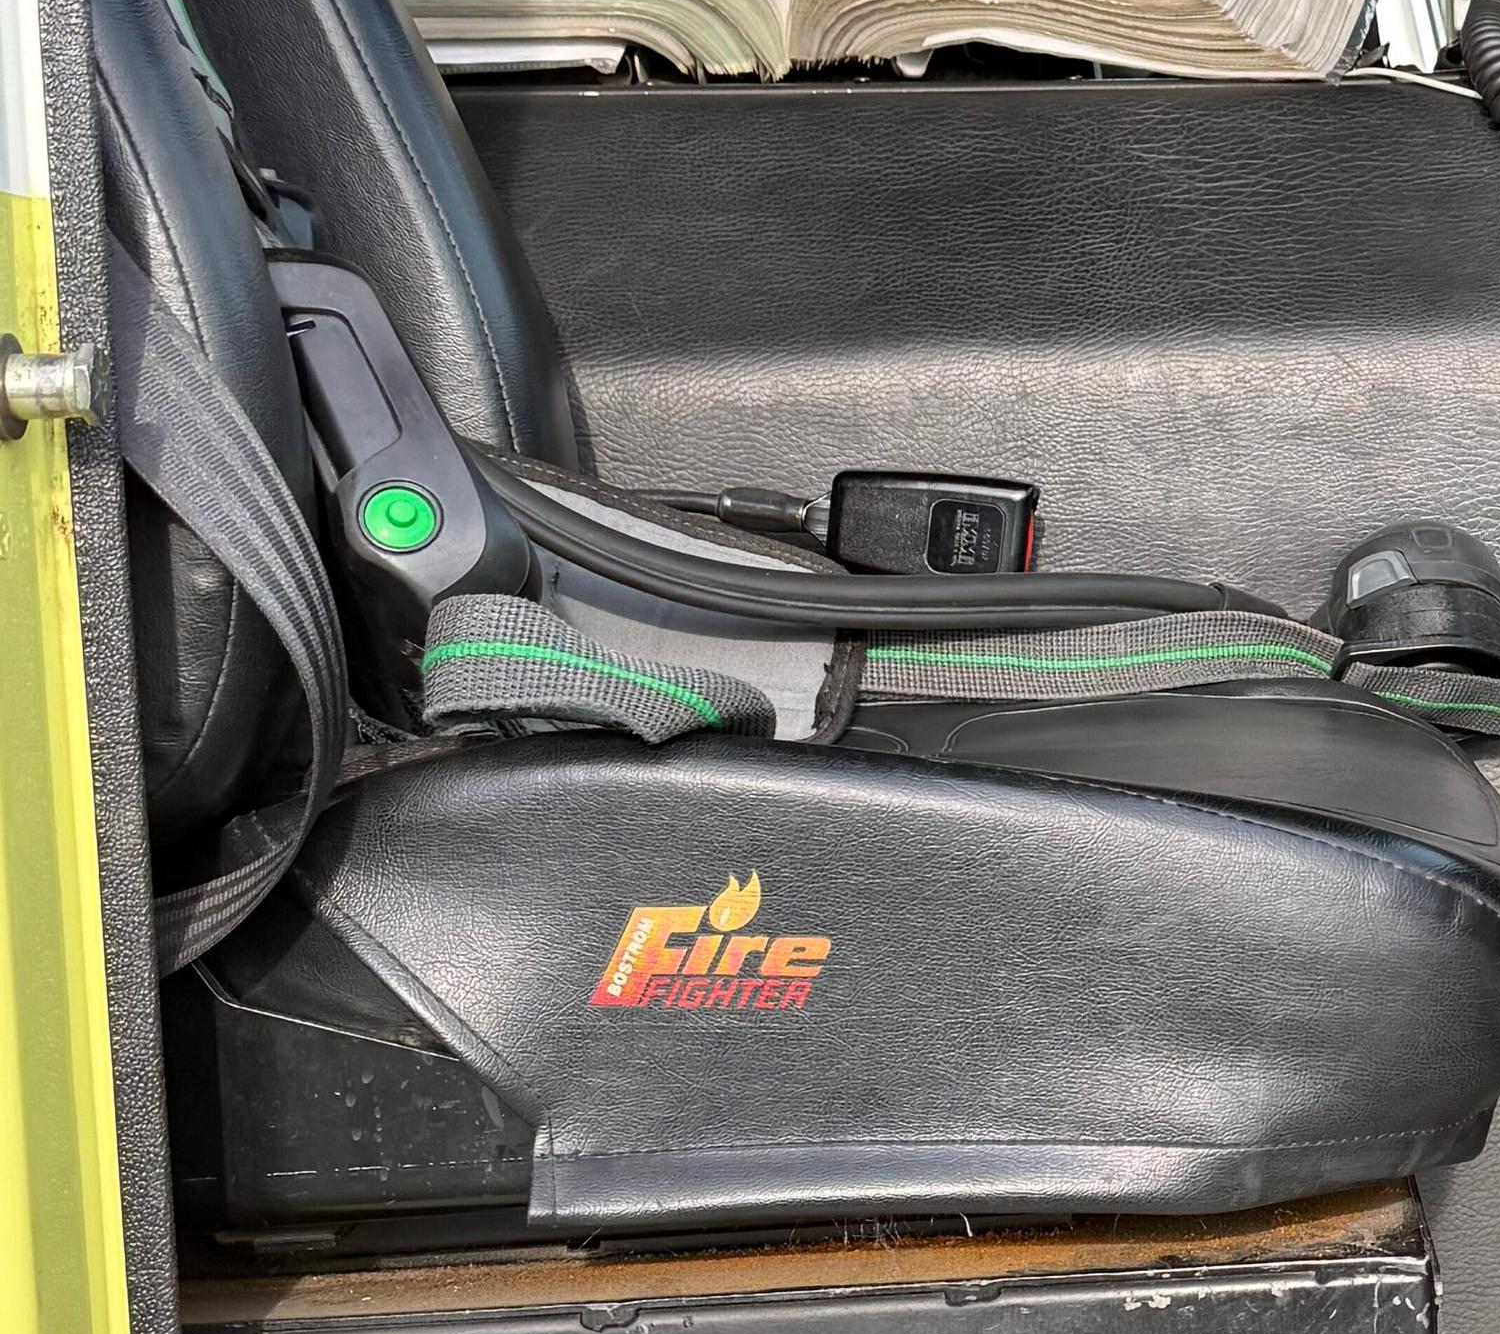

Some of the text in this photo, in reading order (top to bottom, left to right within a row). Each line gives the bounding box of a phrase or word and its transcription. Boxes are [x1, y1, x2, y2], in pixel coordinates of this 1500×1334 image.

[589, 870, 832, 1006] Fire
[607, 917, 655, 997] BOSTROM
[642, 978, 812, 1009] FIGHTER
